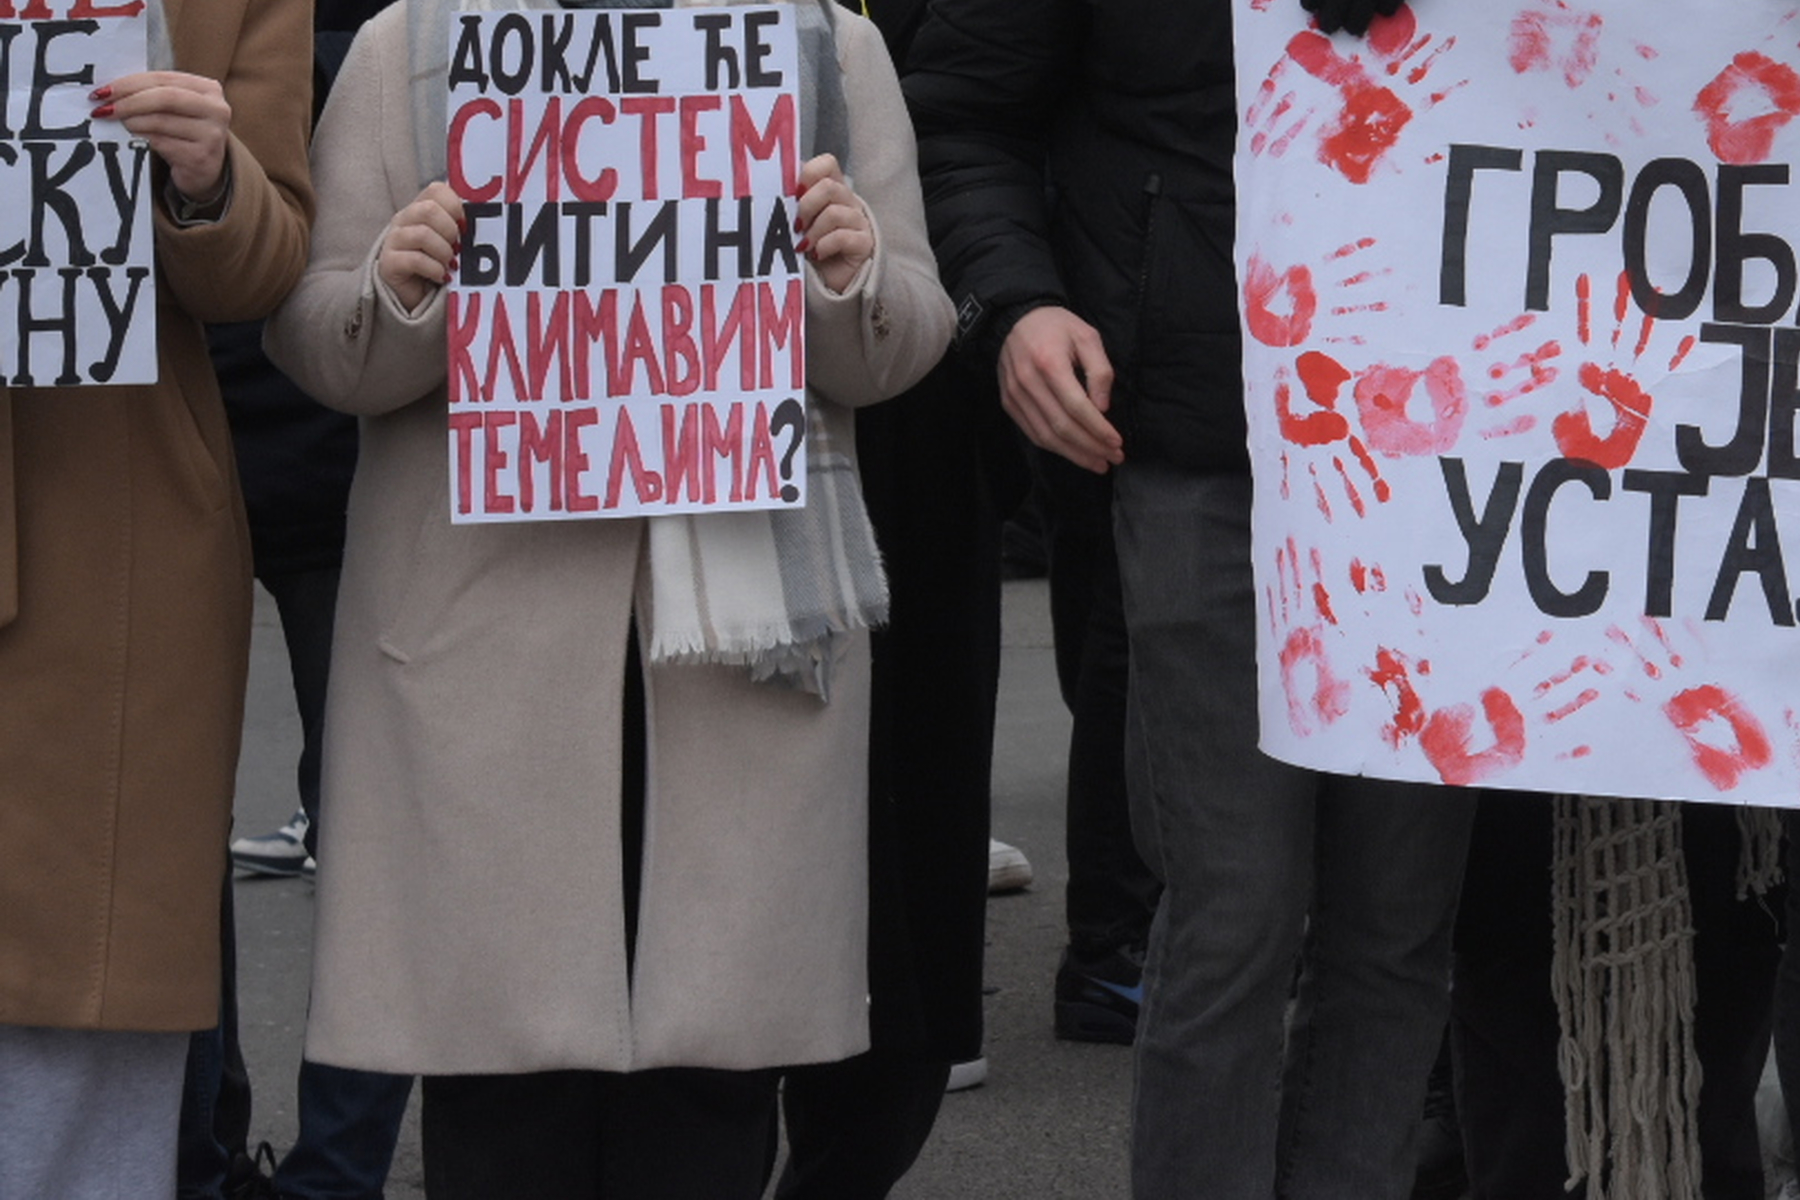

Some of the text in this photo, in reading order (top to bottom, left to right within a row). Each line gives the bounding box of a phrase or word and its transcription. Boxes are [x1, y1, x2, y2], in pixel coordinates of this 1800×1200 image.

[448, 11, 783, 95] ДОКЛЕ ЋЕ
[446, 93, 800, 204] СИСТЕМ
[459, 195, 800, 287] БИТИ НА
[0, 266, 149, 387] НУ
[447, 278, 803, 403] КЛИМАВИМ
[448, 398, 805, 514] ТЕМЕЉИМА?
